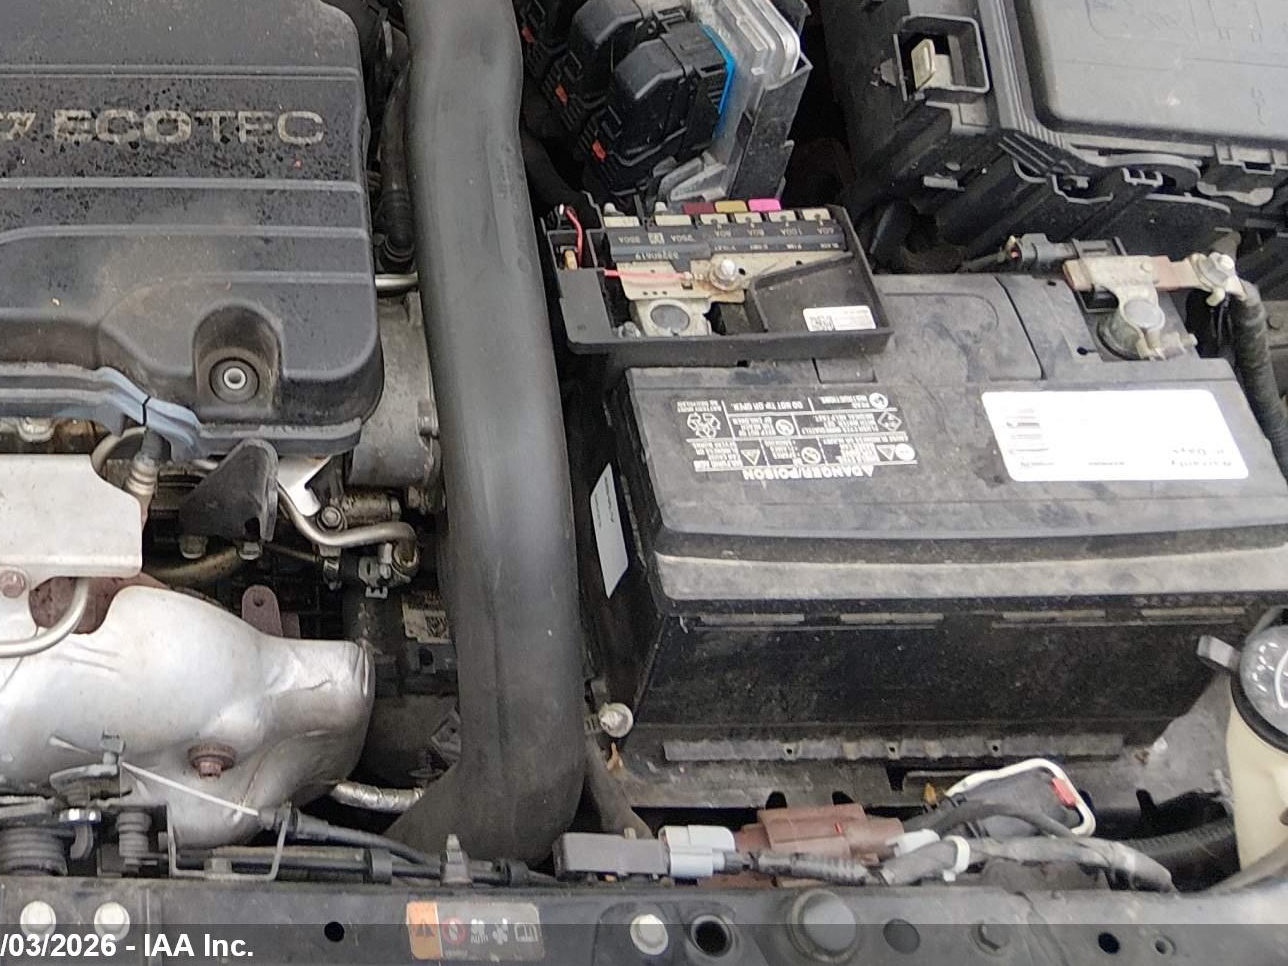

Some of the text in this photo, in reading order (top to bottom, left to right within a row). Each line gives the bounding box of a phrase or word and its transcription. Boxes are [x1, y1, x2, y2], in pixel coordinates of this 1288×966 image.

[53, 109, 324, 145] ECOTEC
[765, 402, 776, 410] TIP
[777, 401, 792, 410] NOT
[792, 401, 803, 409] DO
